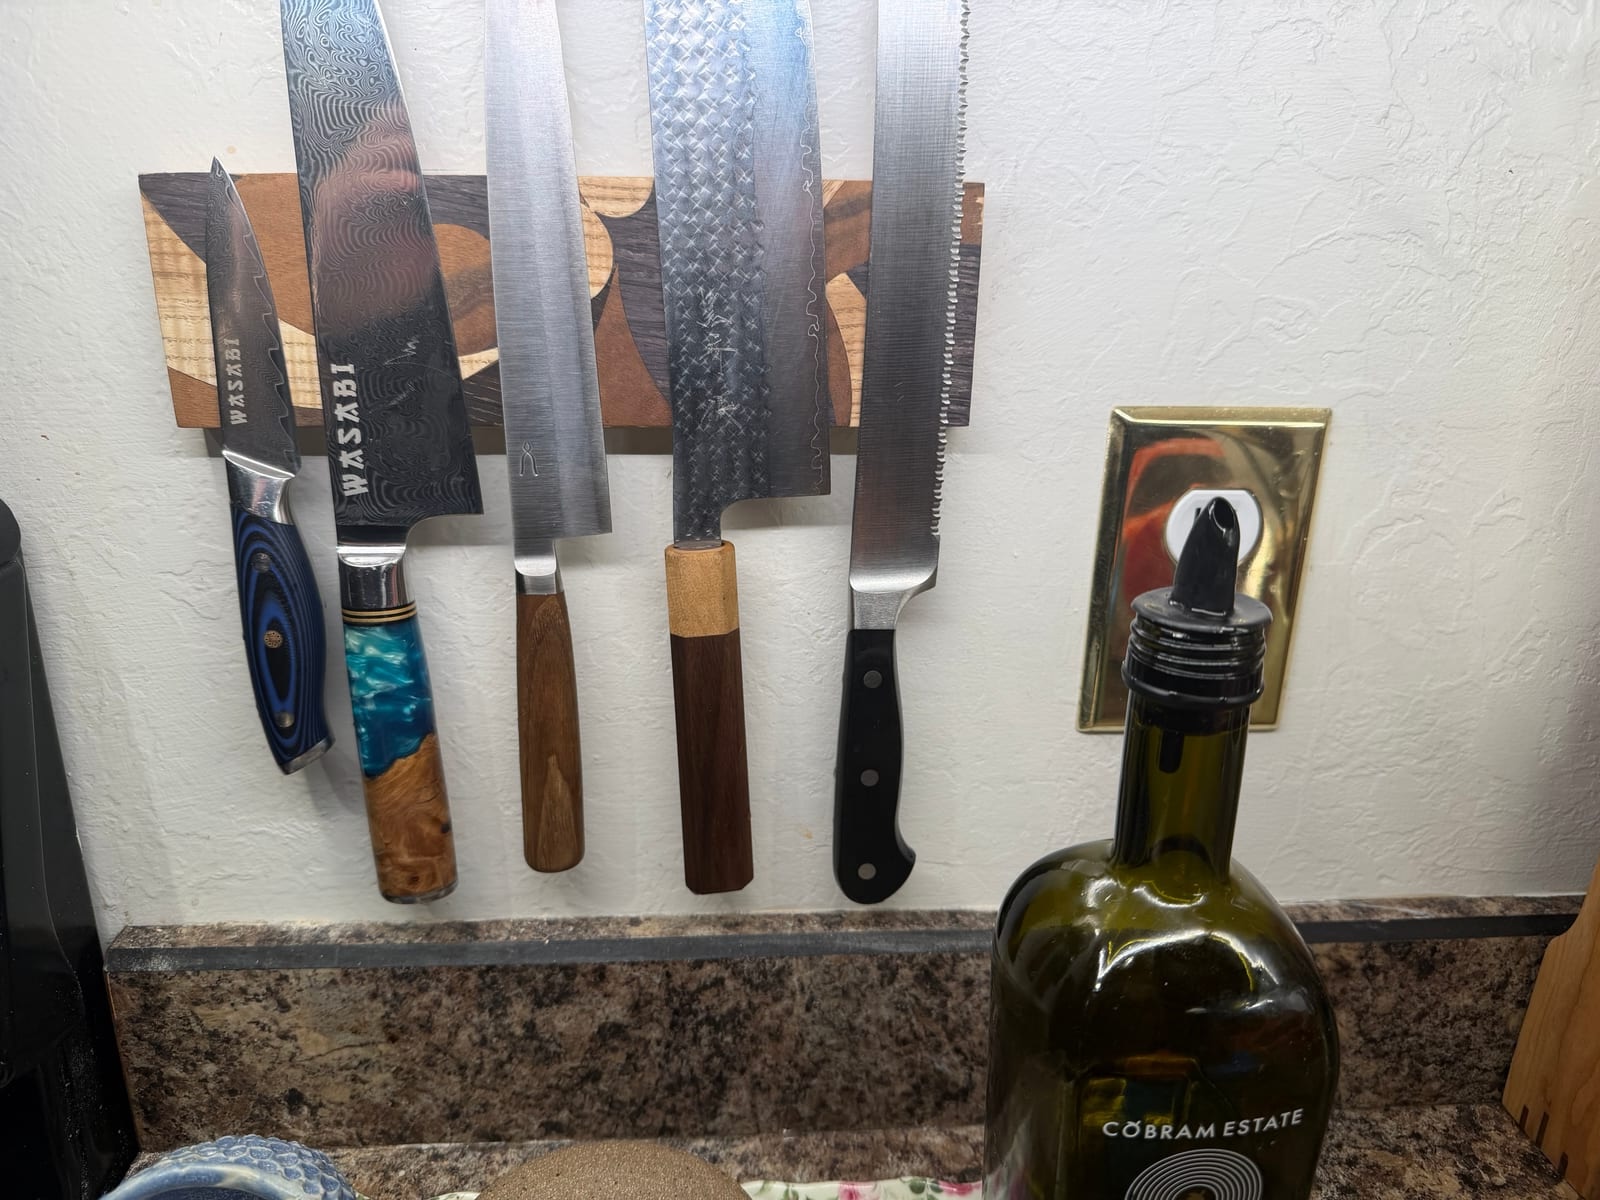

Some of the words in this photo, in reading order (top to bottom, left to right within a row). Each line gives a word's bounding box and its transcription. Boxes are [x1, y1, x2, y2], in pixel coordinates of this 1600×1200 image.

[224, 338, 248, 425] WASABI
[330, 363, 369, 497] WASABI
[1222, 1108, 1304, 1137] ESTATE
